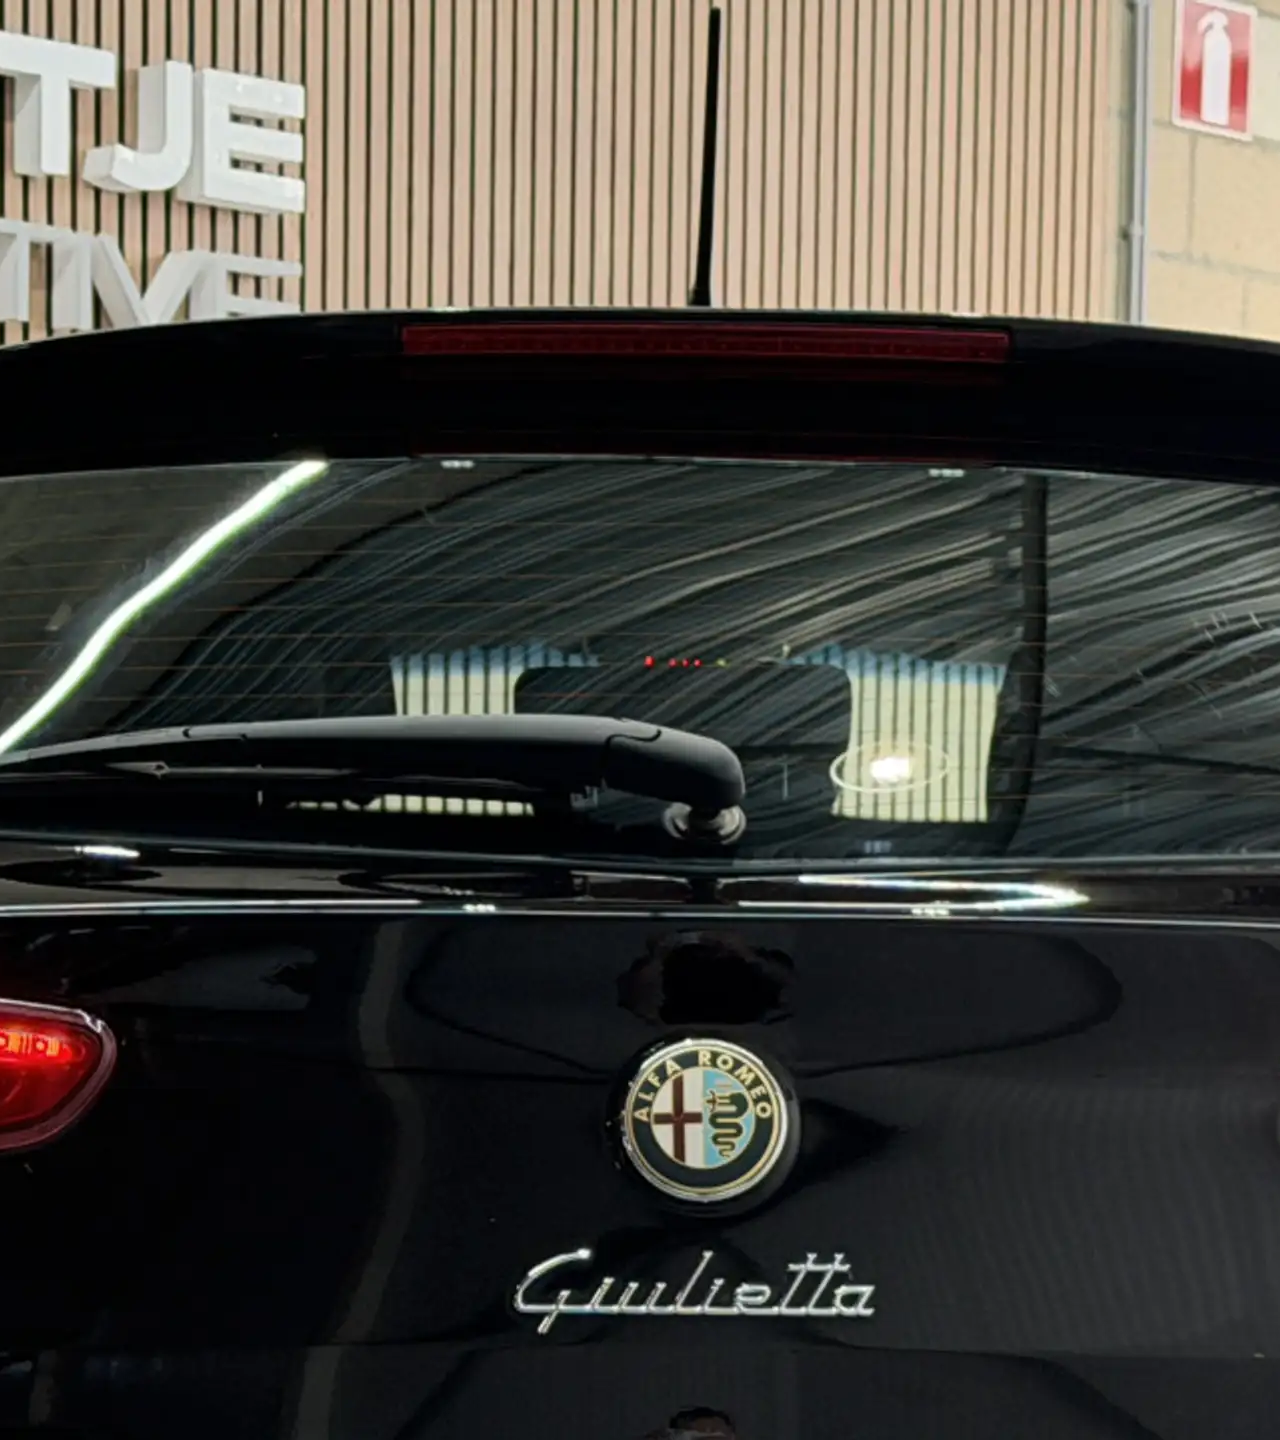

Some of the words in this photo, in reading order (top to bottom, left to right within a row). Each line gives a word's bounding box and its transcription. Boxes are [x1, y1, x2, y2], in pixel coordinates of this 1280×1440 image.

[632, 1059, 683, 1124] ALFA
[697, 1049, 774, 1120] ROMEO
[515, 1247, 876, 1334] Giulietta
